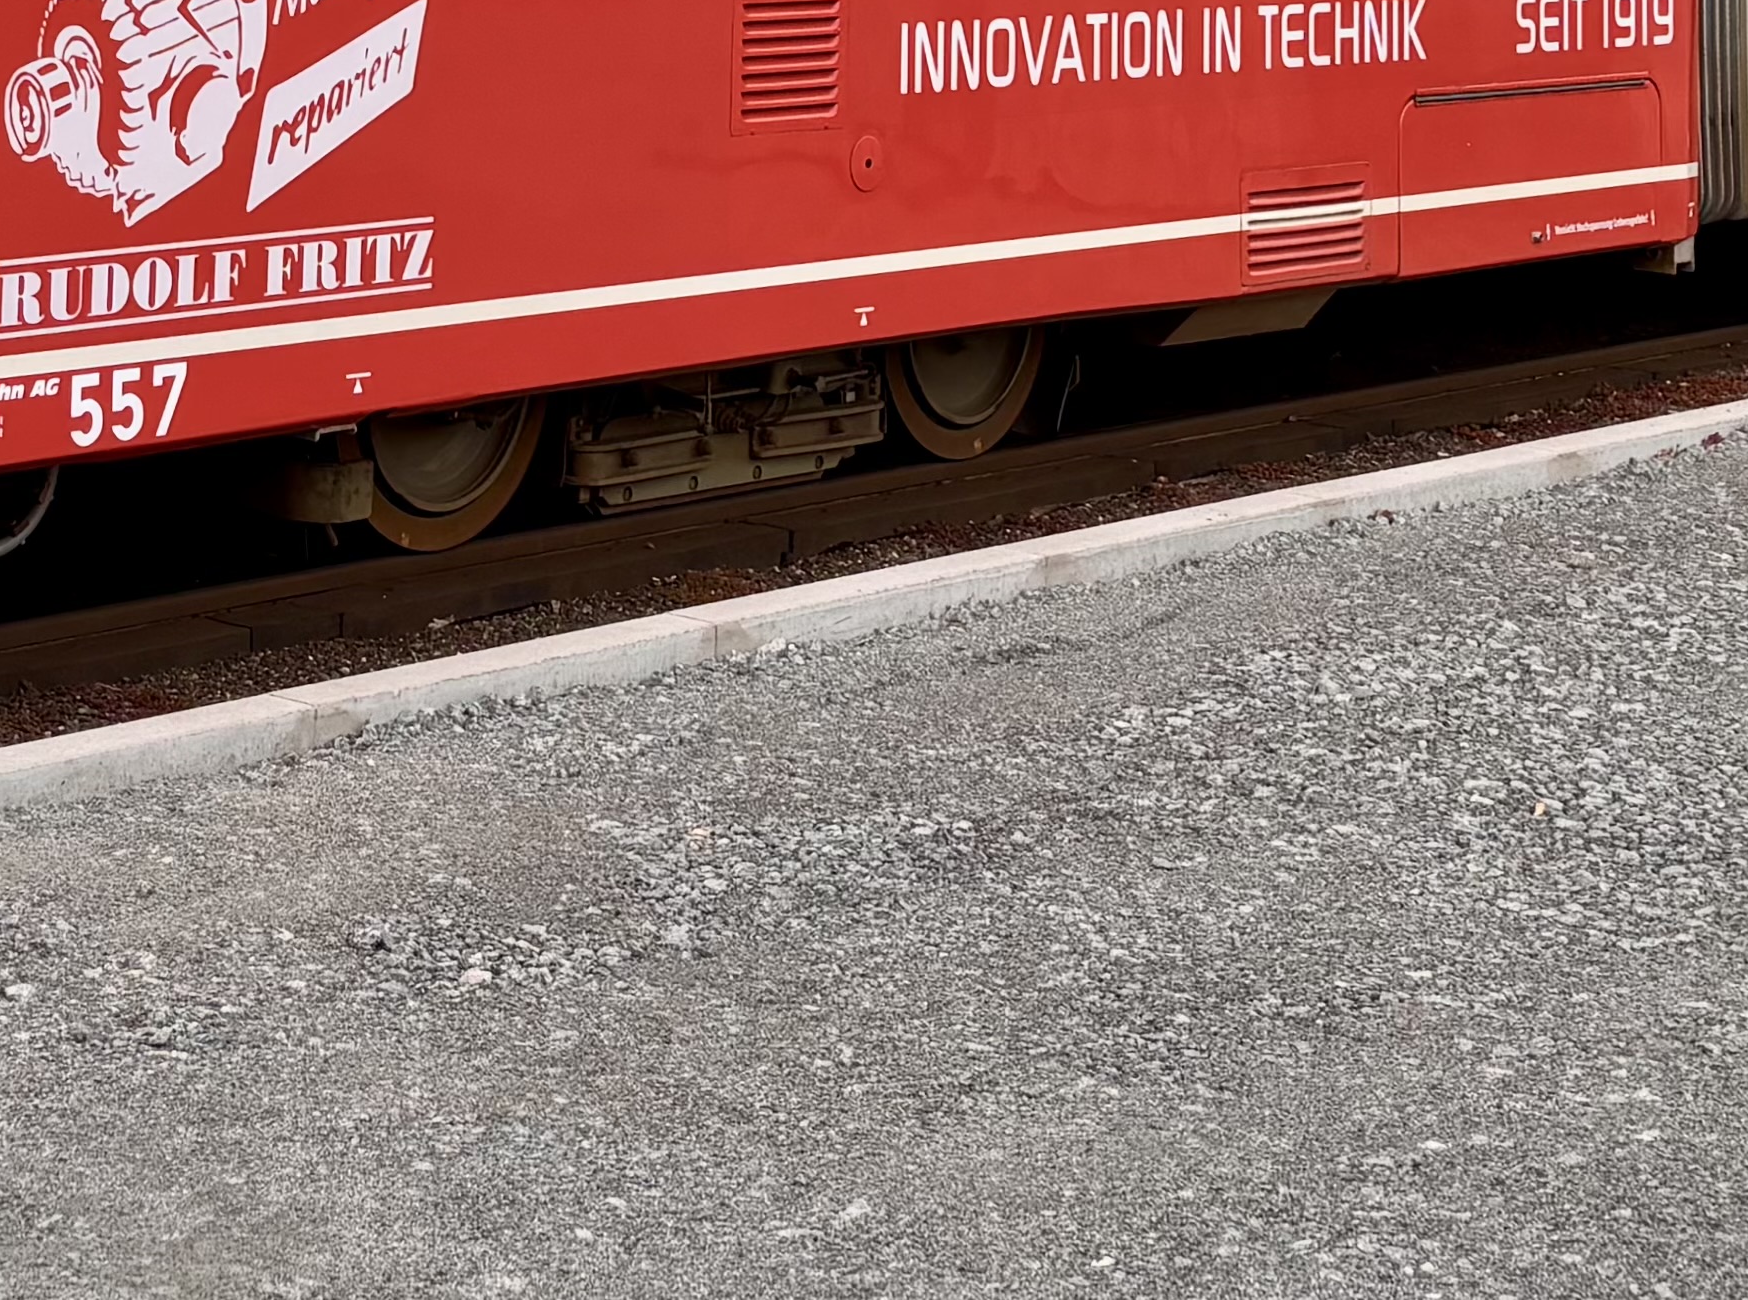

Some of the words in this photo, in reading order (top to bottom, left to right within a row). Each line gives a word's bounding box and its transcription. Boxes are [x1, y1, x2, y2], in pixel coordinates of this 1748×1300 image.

[900, 8, 1183, 95] INNOVATION
[1203, 5, 1241, 74] IN
[268, 28, 409, 166] repariert
[263, 229, 434, 298] FRITZ
[29, 377, 61, 398] AG
[69, 361, 188, 448] 557
